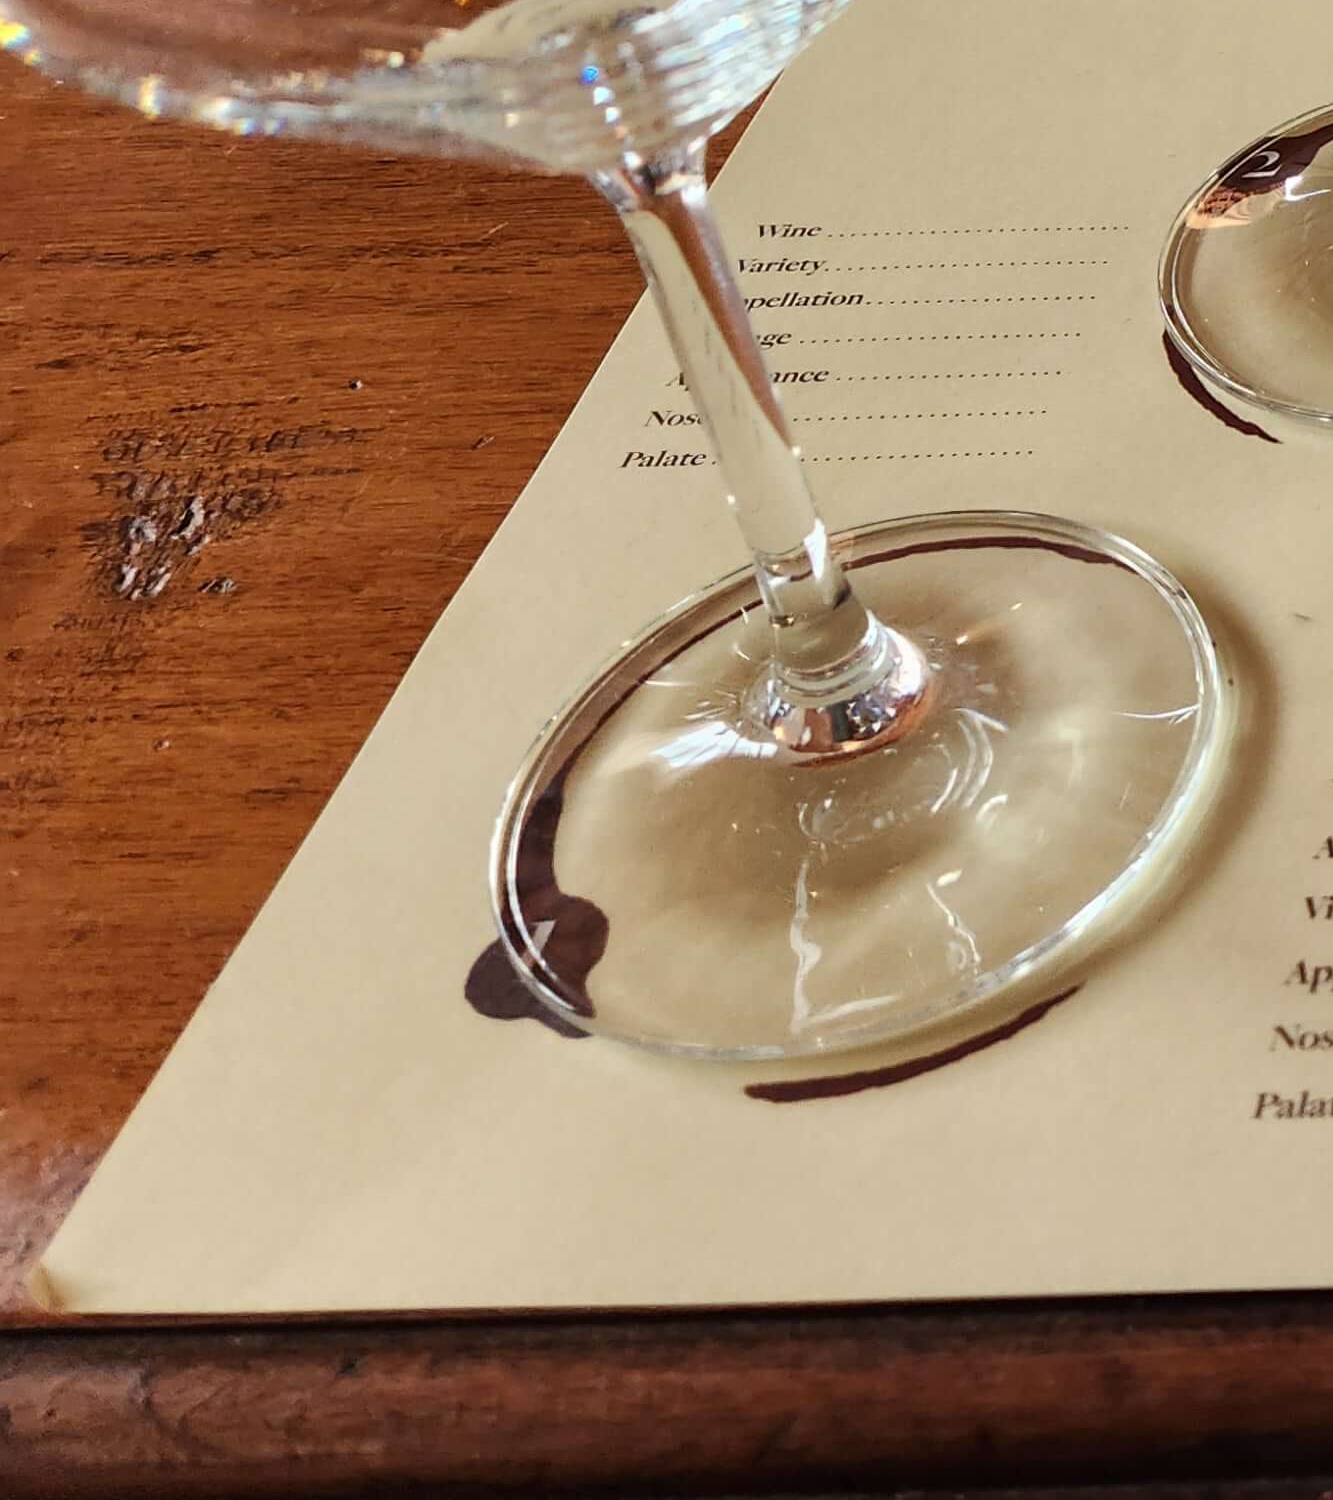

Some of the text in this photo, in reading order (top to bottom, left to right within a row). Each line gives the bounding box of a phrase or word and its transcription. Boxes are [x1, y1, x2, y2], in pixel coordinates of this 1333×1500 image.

[1241, 150, 1281, 179] 2
[757, 223, 822, 239] Wine
[737, 257, 827, 276] Variety
[743, 290, 865, 315] pellation
[620, 450, 707, 469] Palate
